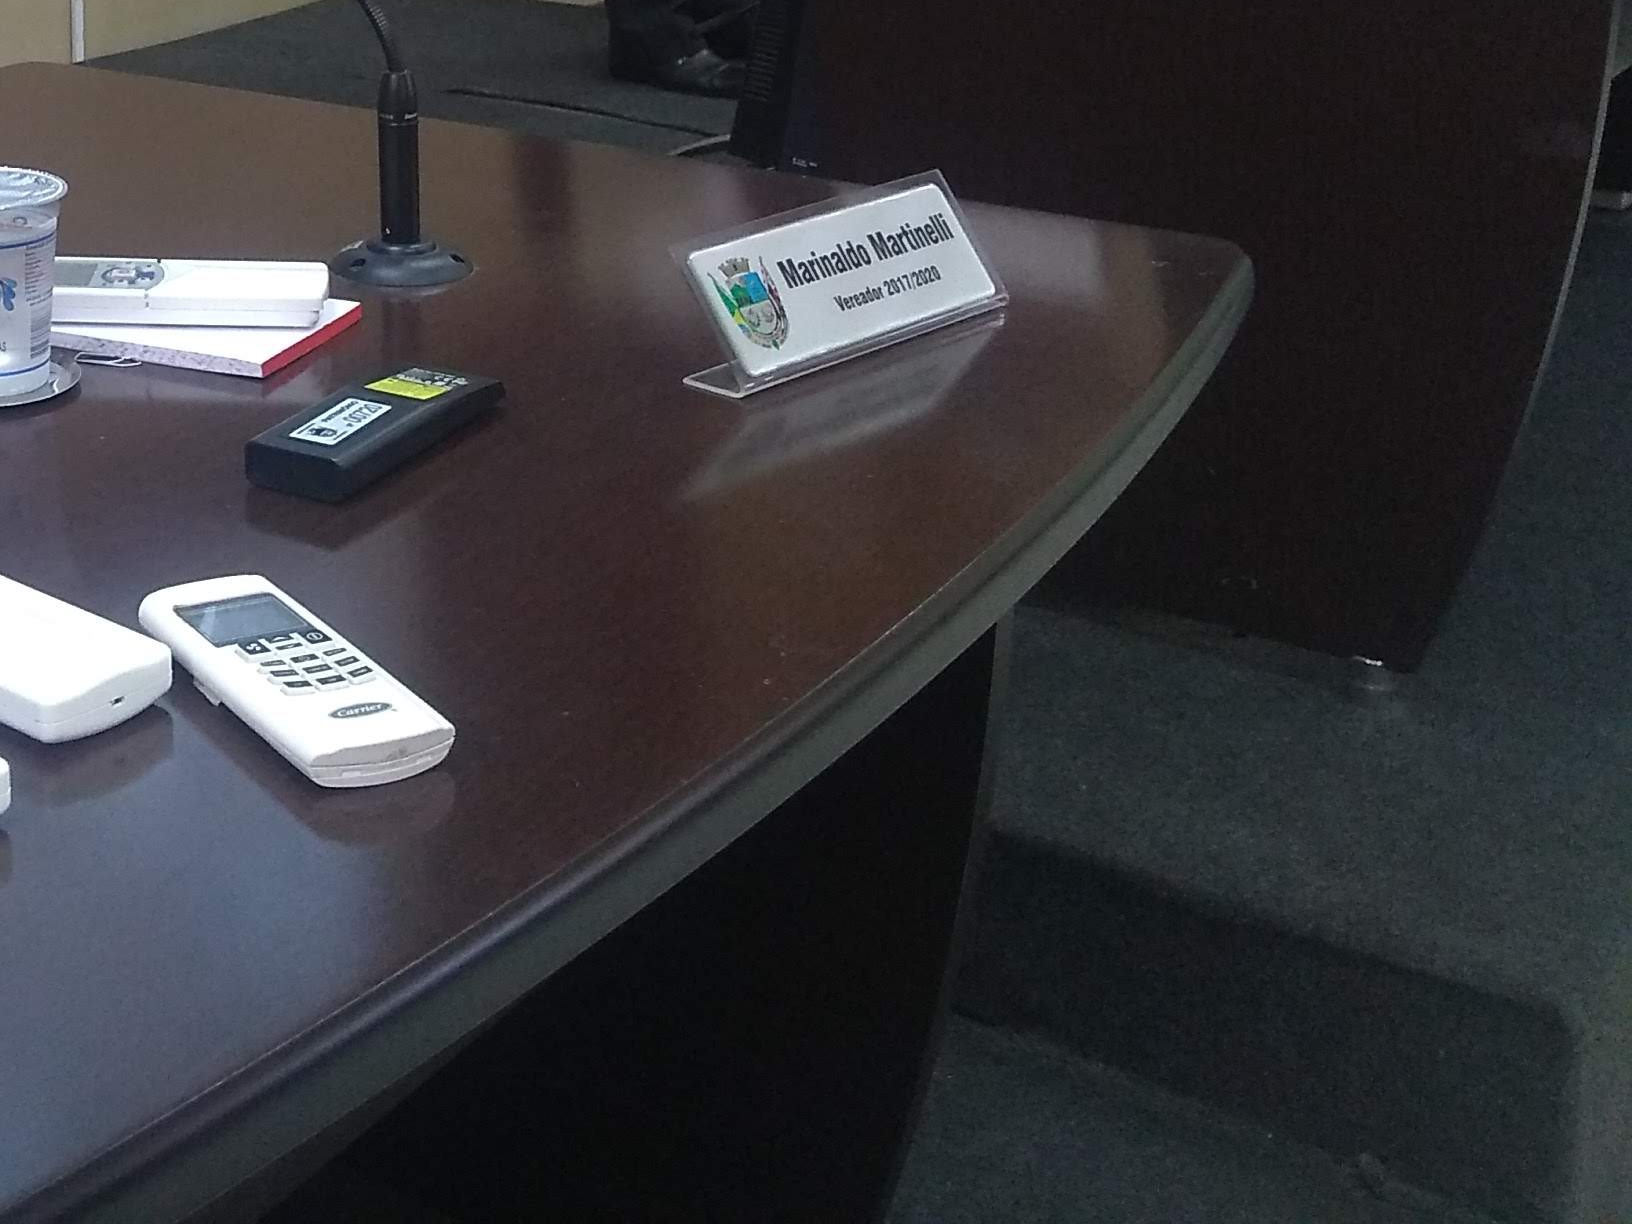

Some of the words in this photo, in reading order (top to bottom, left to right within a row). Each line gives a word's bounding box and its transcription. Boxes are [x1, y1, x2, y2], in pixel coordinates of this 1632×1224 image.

[777, 240, 871, 288] Marinaldo
[867, 213, 954, 261] Martinelli
[834, 285, 885, 312] Vereador
[884, 265, 941, 295] 2017/2020
[336, 703, 384, 718] Carrier
